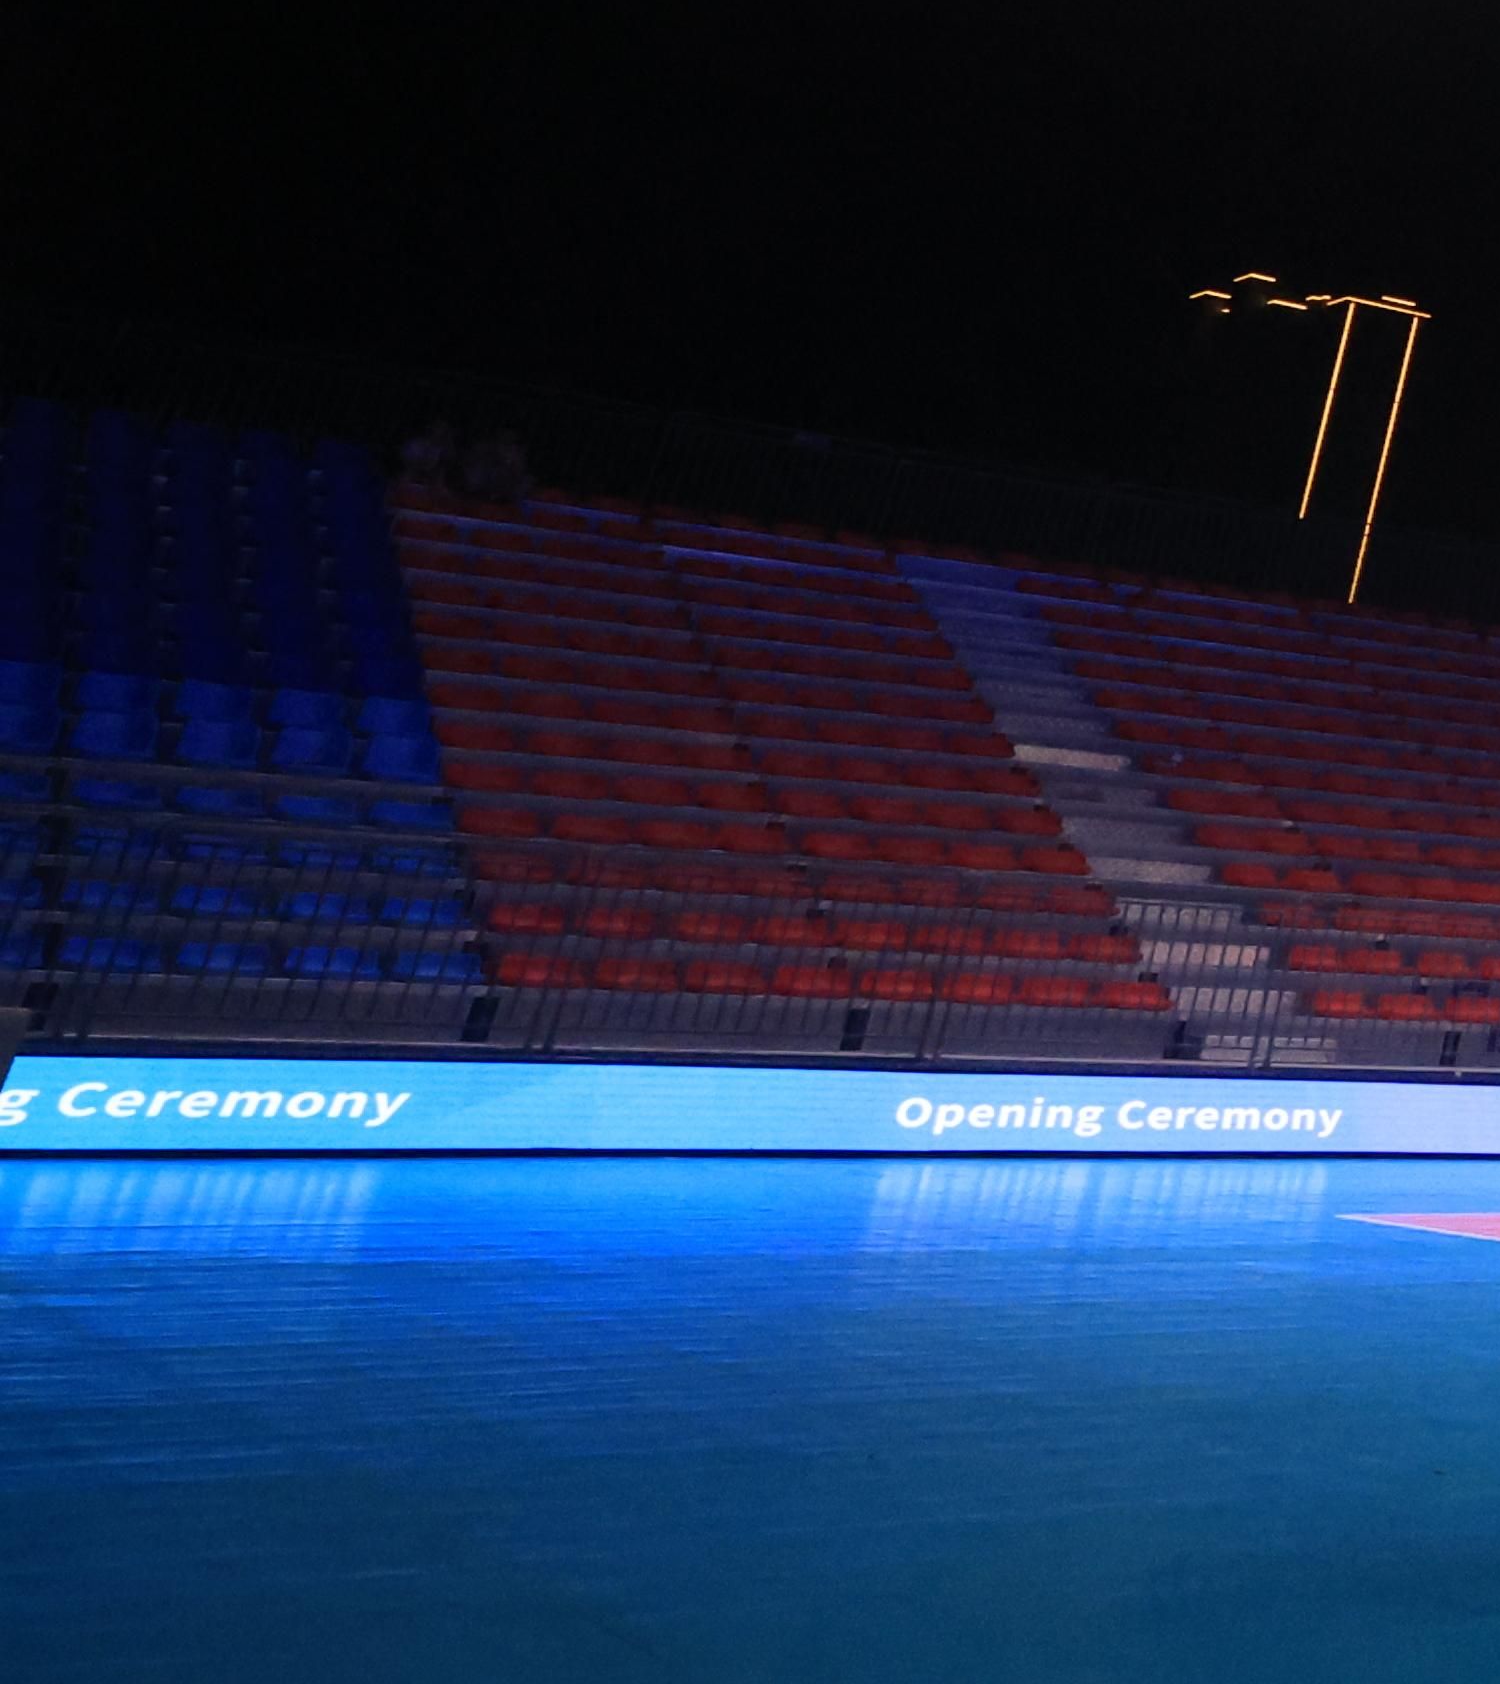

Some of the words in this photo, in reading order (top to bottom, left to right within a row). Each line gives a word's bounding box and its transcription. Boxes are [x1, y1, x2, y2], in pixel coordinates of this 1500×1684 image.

[57, 1081, 410, 1128] Ceremony
[895, 1096, 1103, 1137] Opening
[1116, 1099, 1342, 1139] Ceremony
